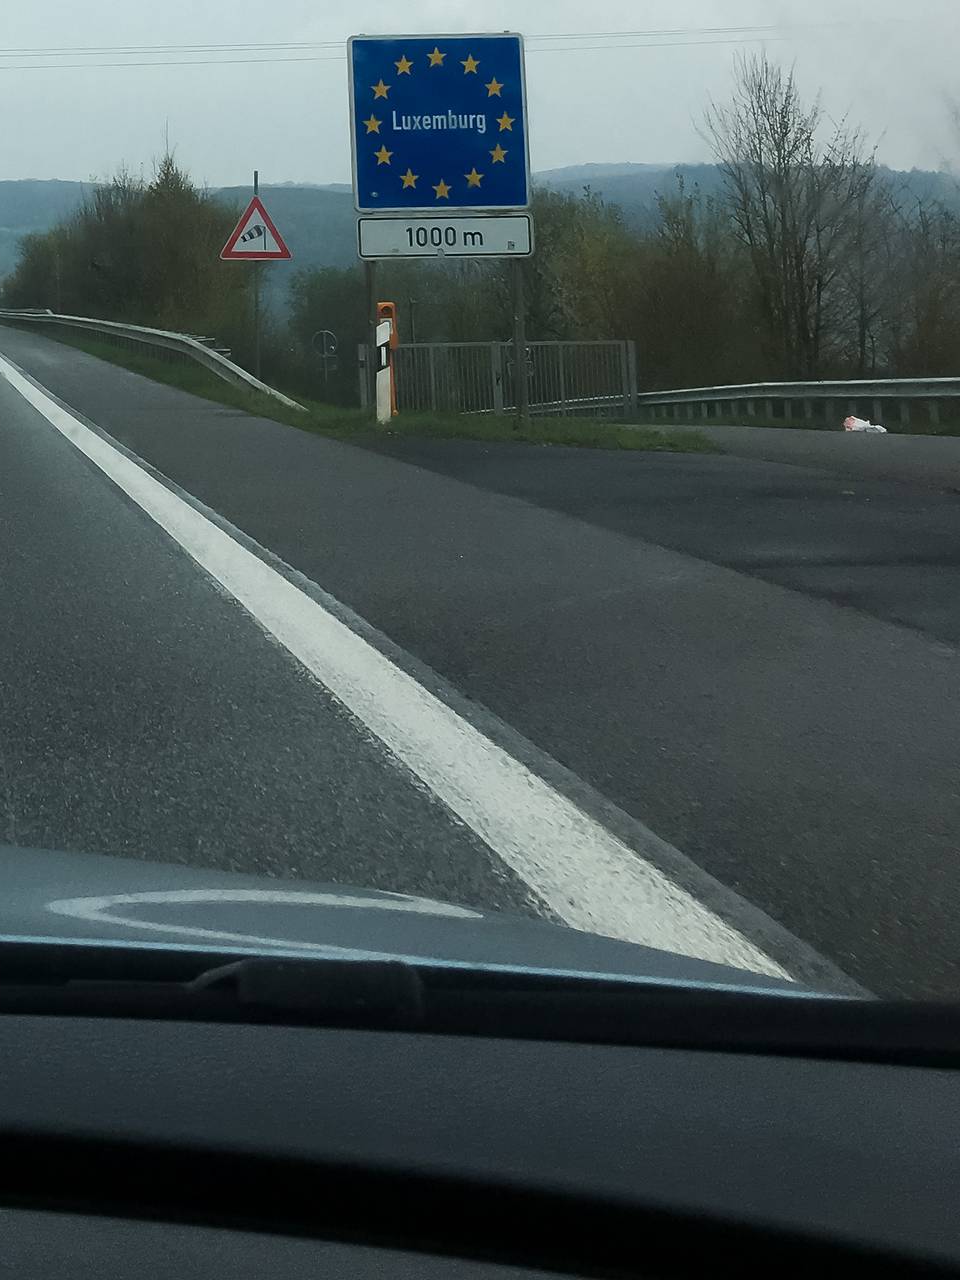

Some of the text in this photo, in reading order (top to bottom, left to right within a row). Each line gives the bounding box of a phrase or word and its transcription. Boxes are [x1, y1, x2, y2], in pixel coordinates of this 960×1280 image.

[392, 110, 486, 134] Luxemburg
[405, 226, 484, 248] 1000 m
